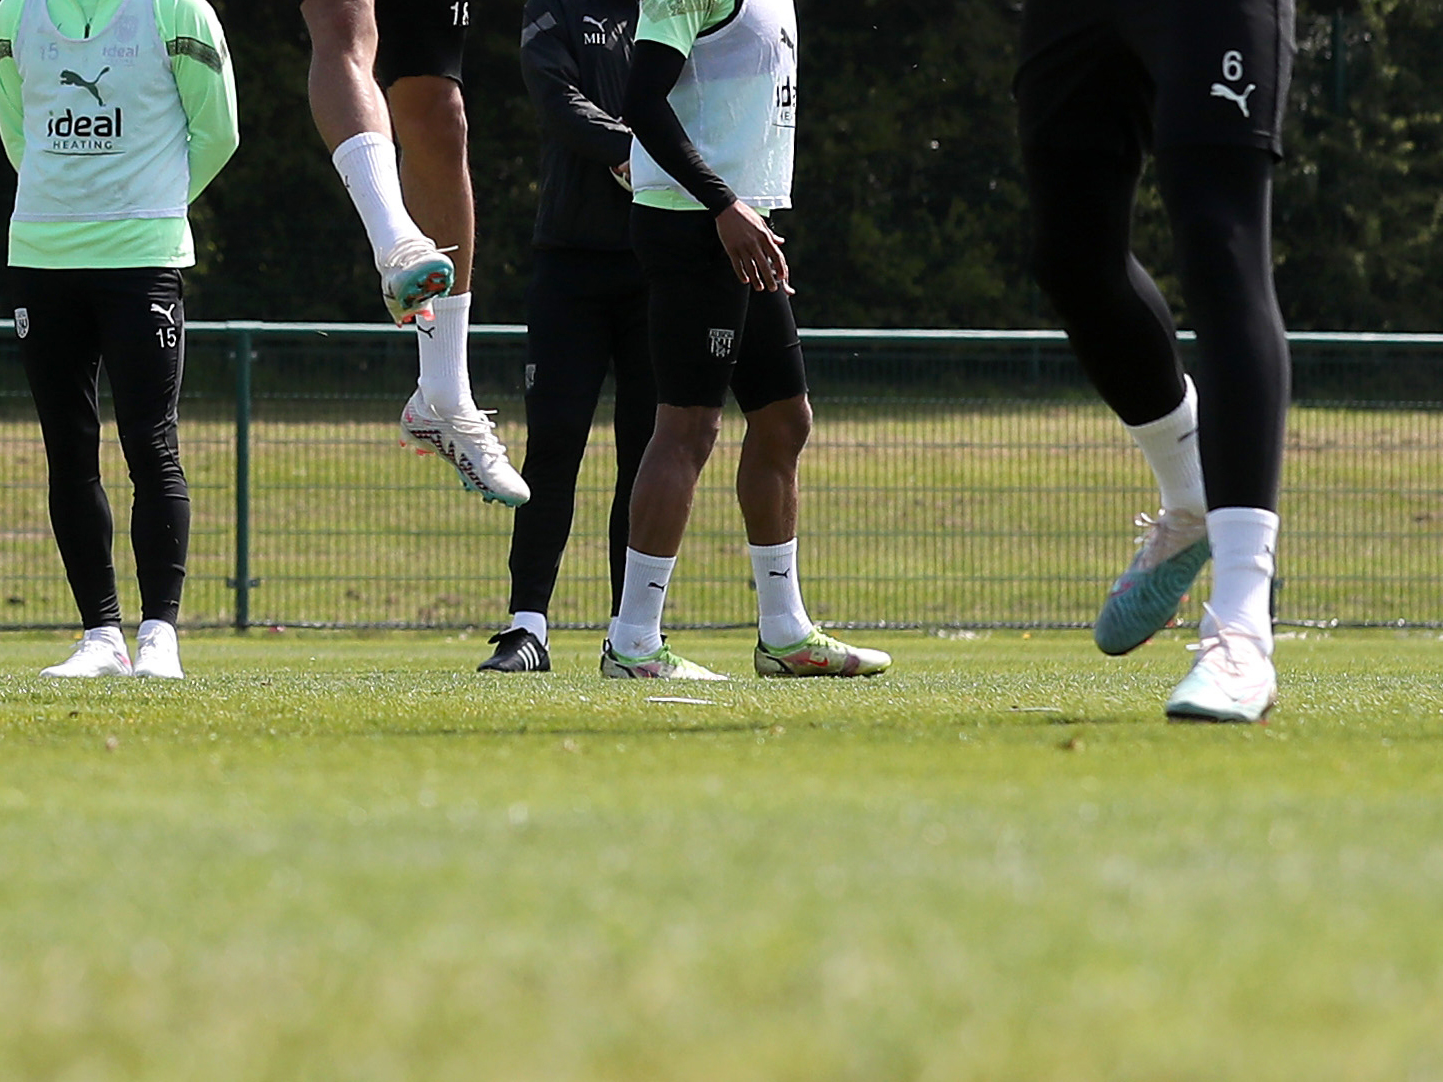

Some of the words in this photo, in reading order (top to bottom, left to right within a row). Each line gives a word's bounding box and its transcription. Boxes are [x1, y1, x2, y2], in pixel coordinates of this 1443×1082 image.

[103, 45, 139, 58] ideal
[1222, 49, 1243, 81] 6
[47, 107, 122, 138] ideal
[53, 140, 113, 150] HEATING
[155, 327, 177, 348] 15
